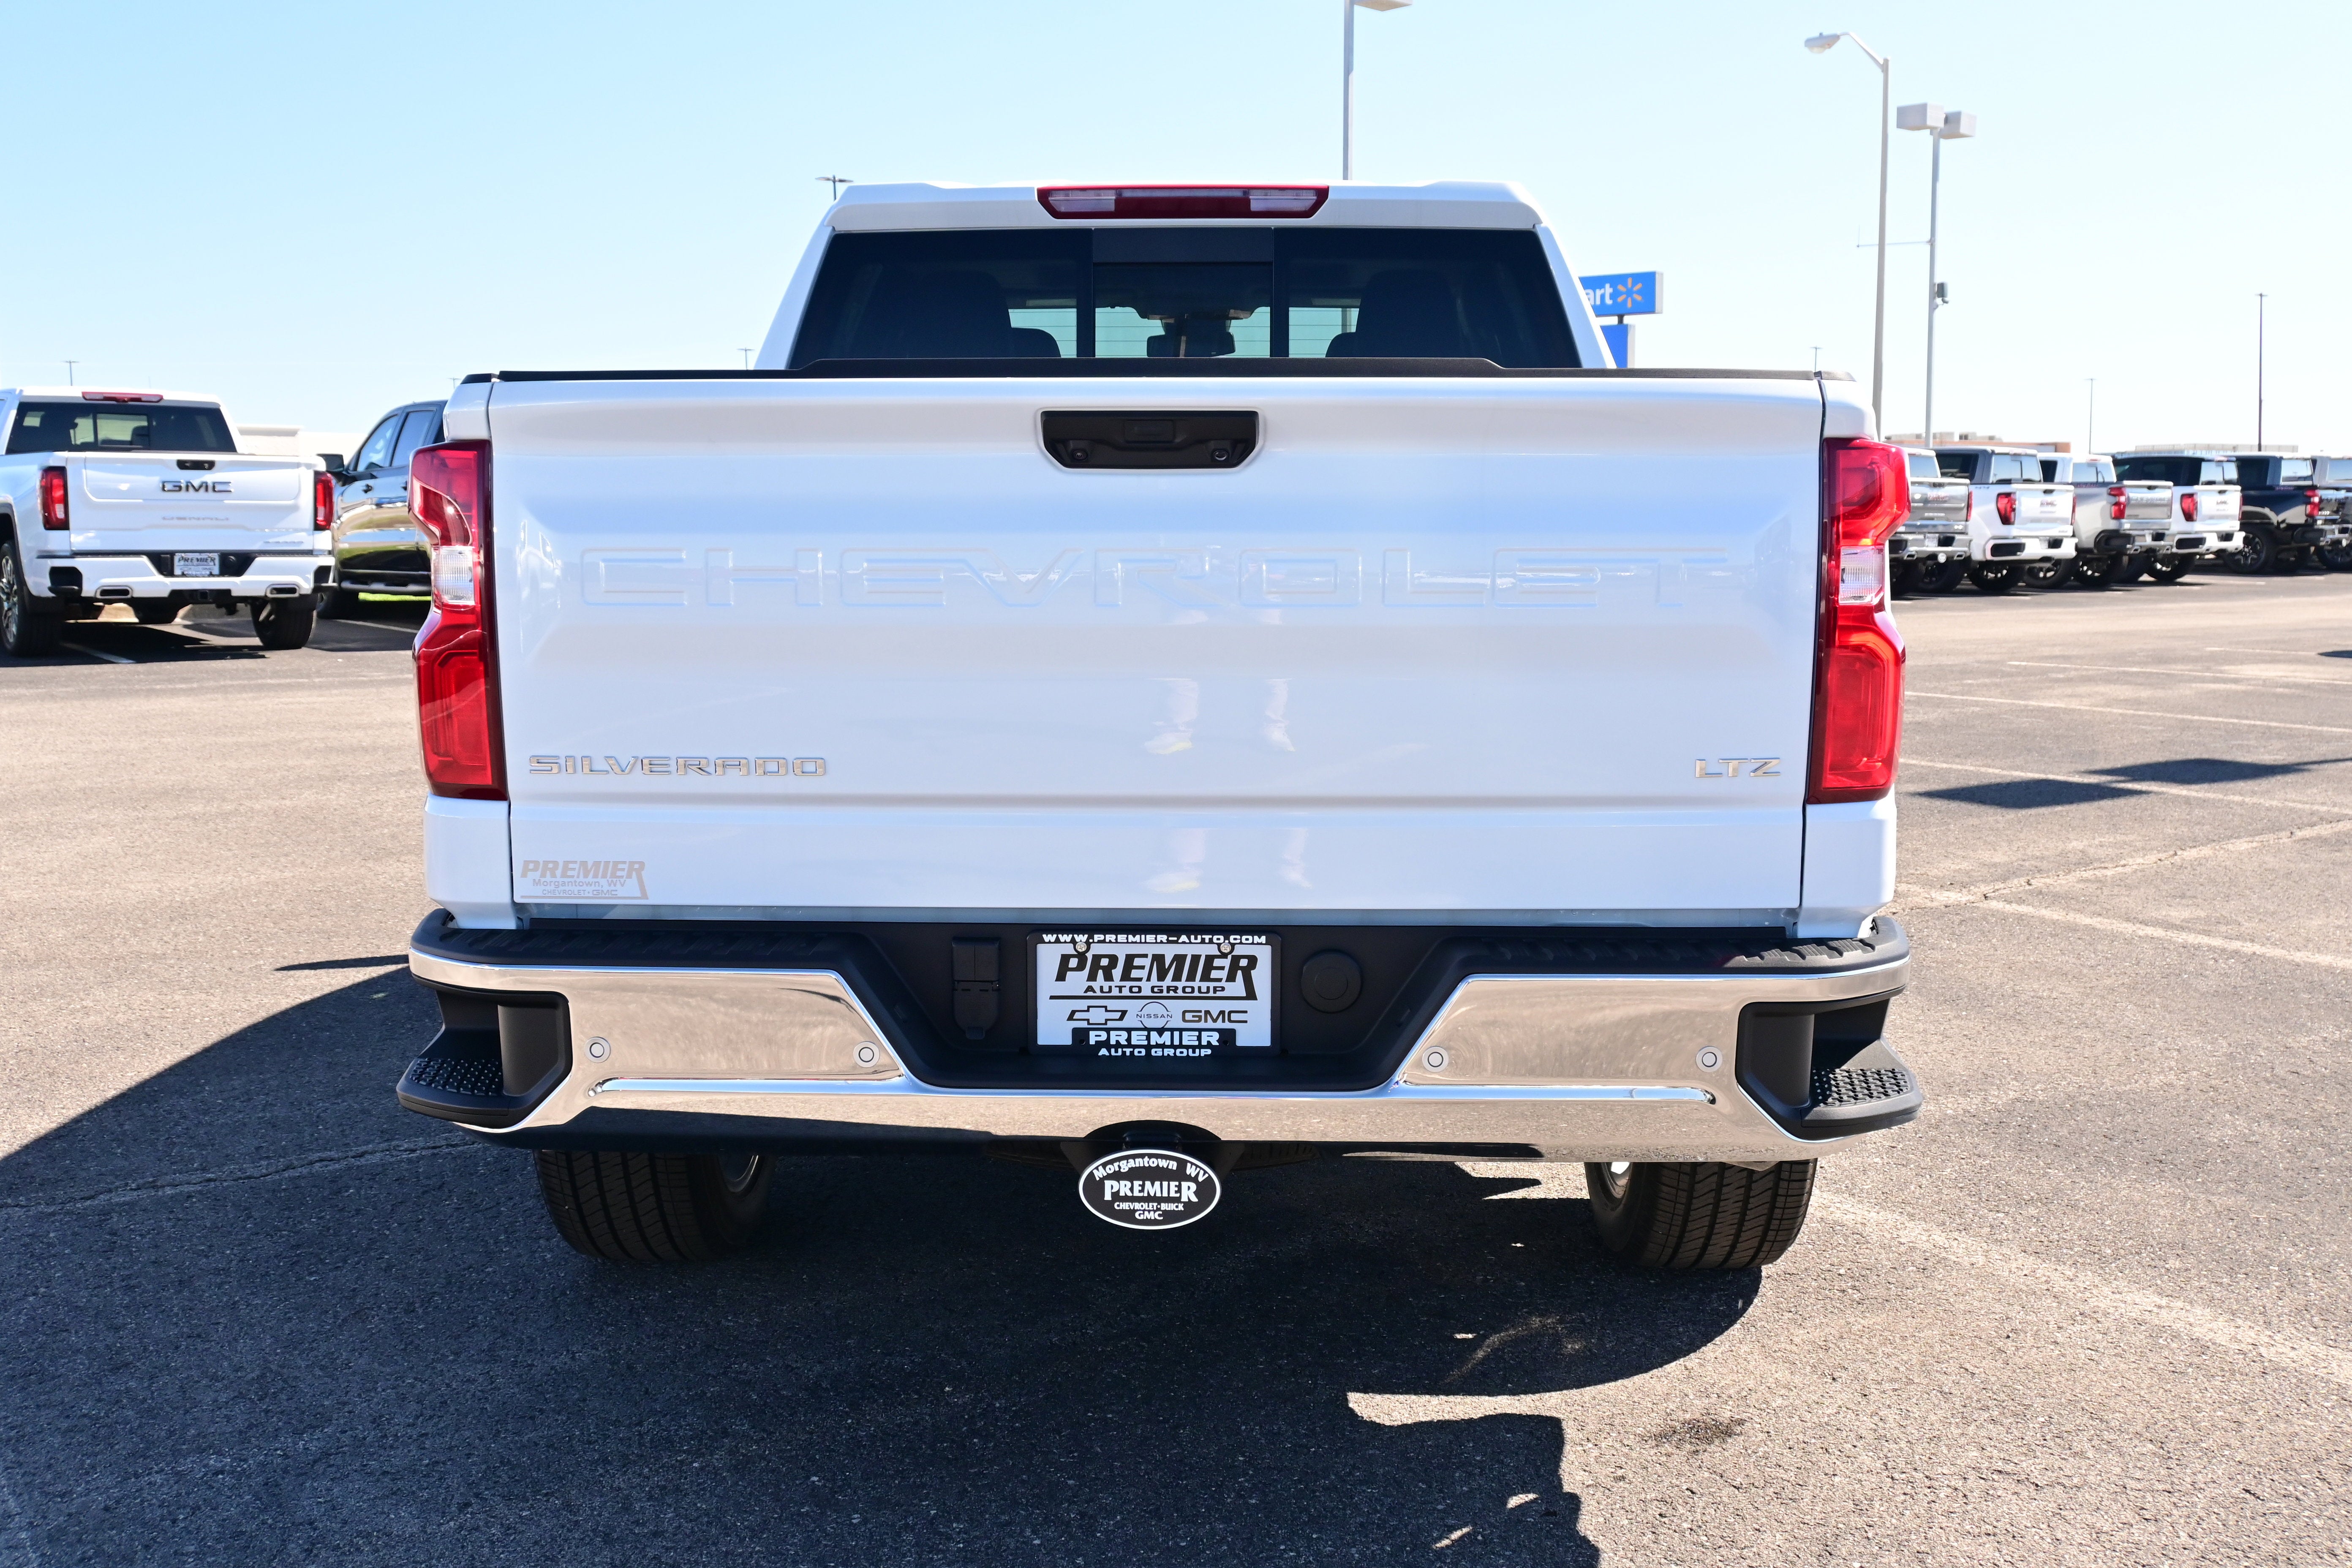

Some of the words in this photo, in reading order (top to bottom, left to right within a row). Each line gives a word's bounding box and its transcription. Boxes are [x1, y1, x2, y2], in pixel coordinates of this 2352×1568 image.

[161, 480, 234, 493] GMC
[178, 556, 215, 566] PREMIER
[581, 547, 1728, 608] CHEVROLET
[529, 755, 826, 776] SILVERADO
[1695, 757, 1781, 778] LTZ
[520, 860, 647, 896] PREMIER
[532, 879, 604, 888] Morgantown,
[607, 879, 626, 887] WV
[1042, 934, 1266, 944] WWW.PREMIER-AUTO.COM
[1055, 954, 1258, 1000] PREMIER
[1083, 985, 1142, 994] AUTO
[1151, 985, 1225, 994] GROUP
[1181, 1010, 1248, 1024] GMC
[1089, 1031, 1220, 1045] PREMIER
[1098, 1048, 1146, 1056] AUTO
[1151, 1048, 1211, 1056] GROUP
[1092, 1156, 1178, 1181] Morgantown
[1186, 1162, 1209, 1182] WV
[1104, 1180, 1198, 1202] PREMIER
[1135, 1211, 1163, 1220] GMC
